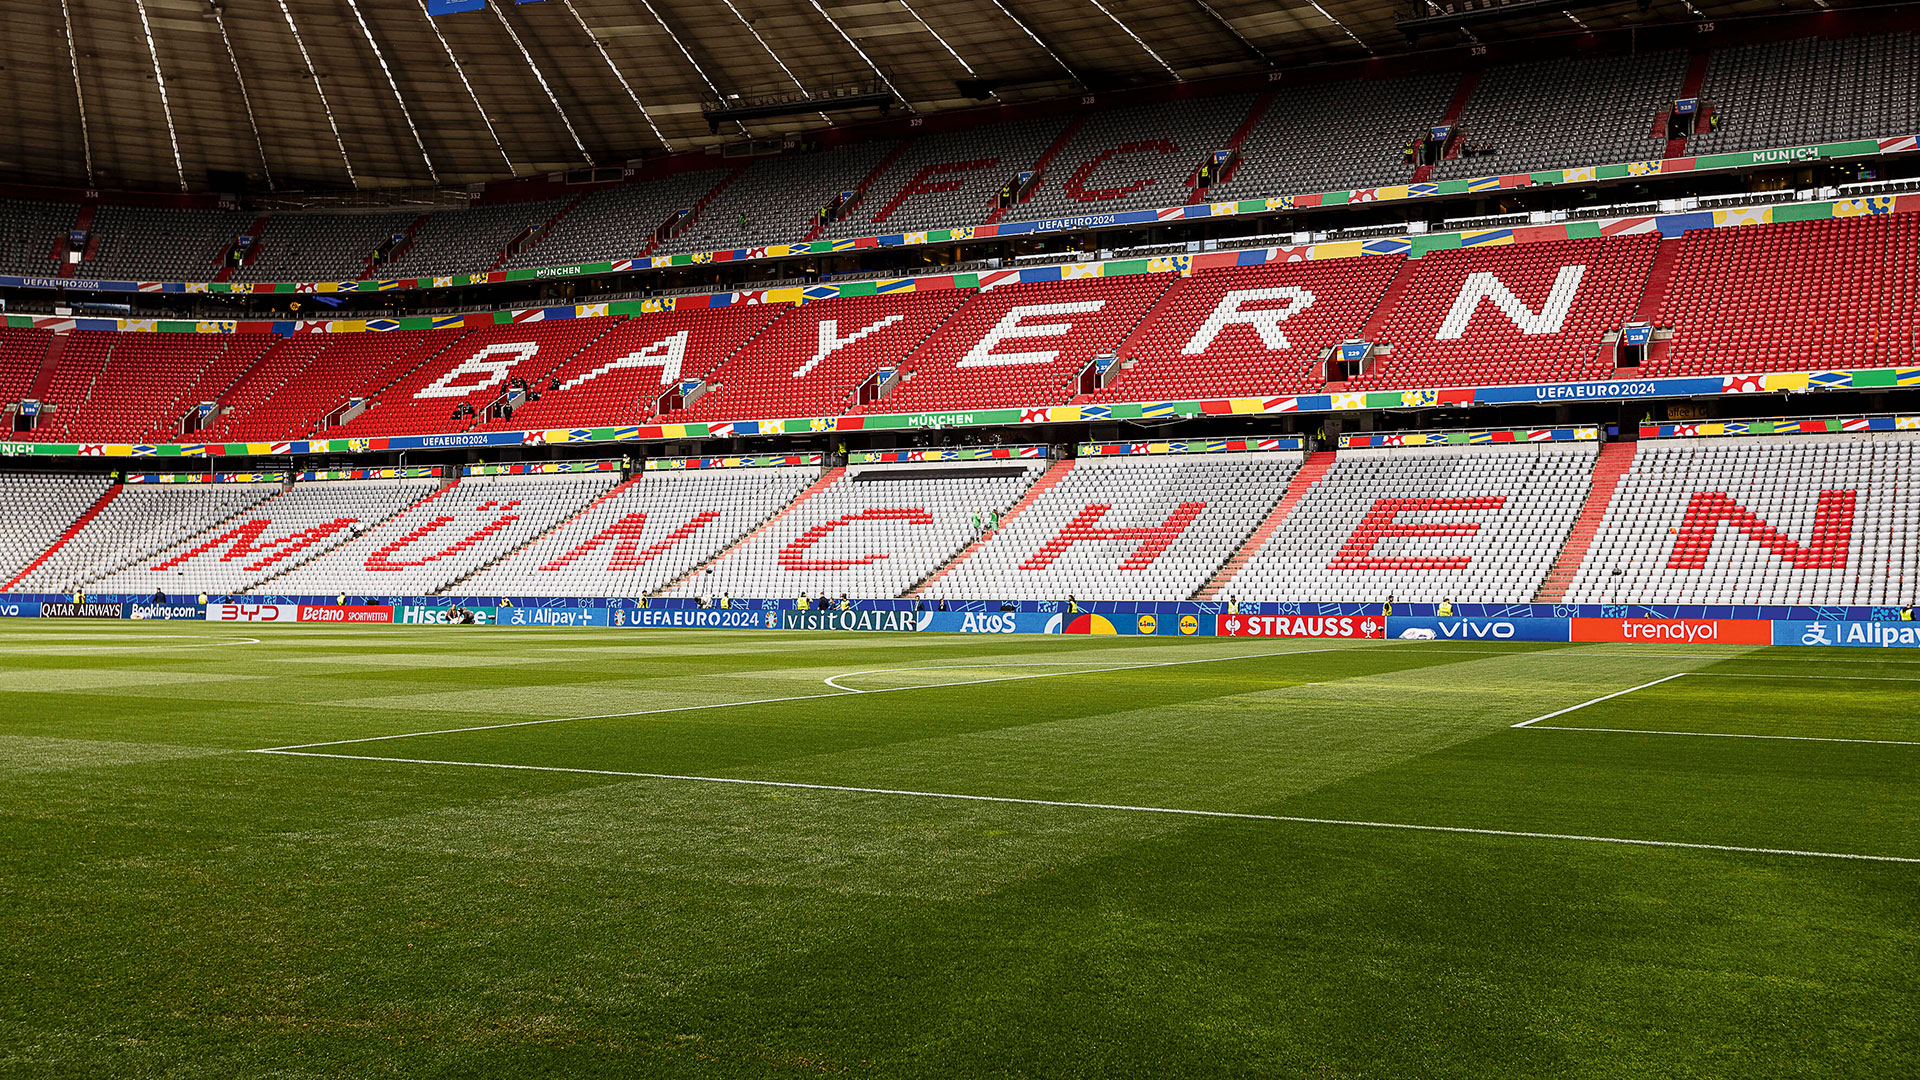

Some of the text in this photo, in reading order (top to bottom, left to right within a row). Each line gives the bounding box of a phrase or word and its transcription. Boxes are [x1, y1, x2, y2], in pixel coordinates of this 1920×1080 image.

[1697, 22, 1715, 33] 325
[1753, 147, 1819, 162] MUNICH
[536, 266, 581, 277] MÜNCHEN
[908, 413, 973, 427] MÜNCHEN
[0, 444, 34, 454] NICH
[42, 603, 122, 618] QATAR AIRWAYS
[131, 604, 196, 620] Booking.com
[221, 604, 280, 622] BYD
[302, 606, 389, 622] Betano SPORTWETTEN
[403, 606, 487, 625] Hisee
[1246, 616, 1354, 637] STRAUSS
[1621, 619, 1719, 643] trendyol
